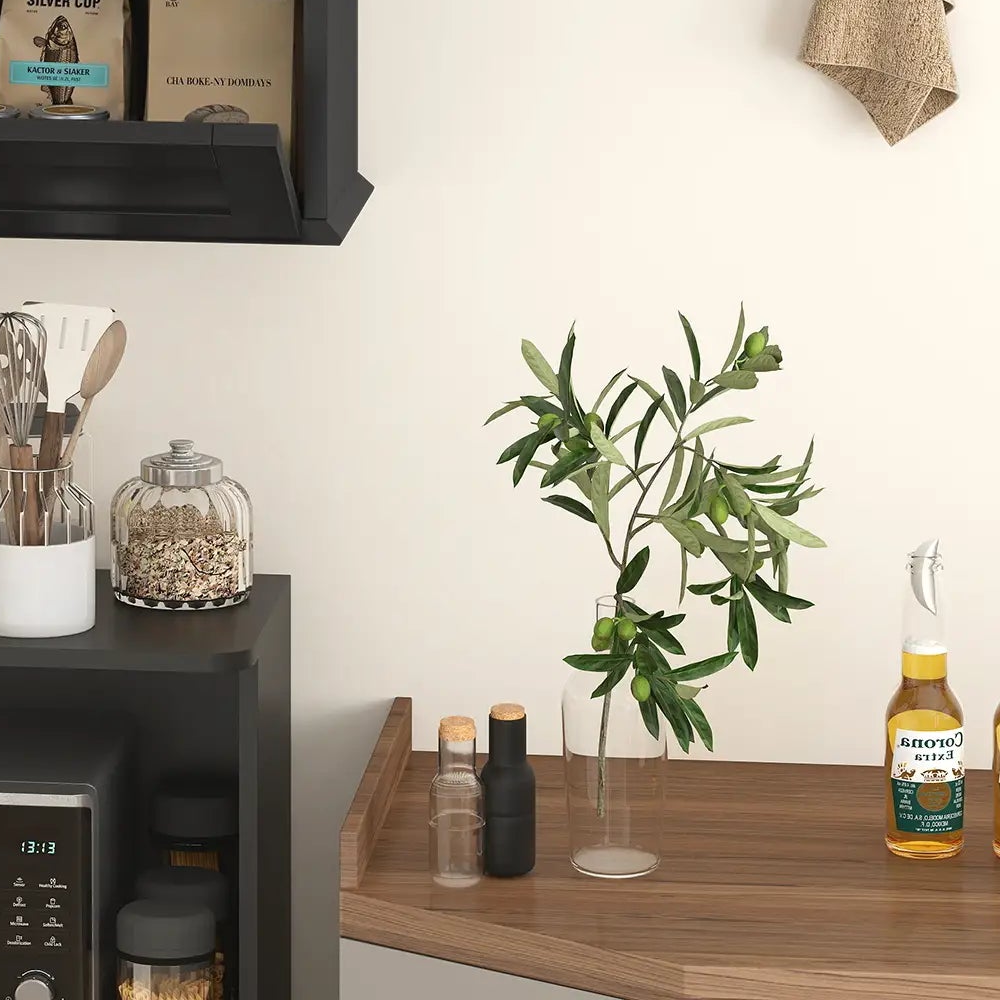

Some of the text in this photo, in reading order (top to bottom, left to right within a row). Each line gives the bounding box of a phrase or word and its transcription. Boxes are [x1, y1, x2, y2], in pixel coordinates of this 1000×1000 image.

[166, 77, 184, 85] CHA
[227, 78, 272, 87] DOMDAYS
[21, 841, 56, 855] 13:13
